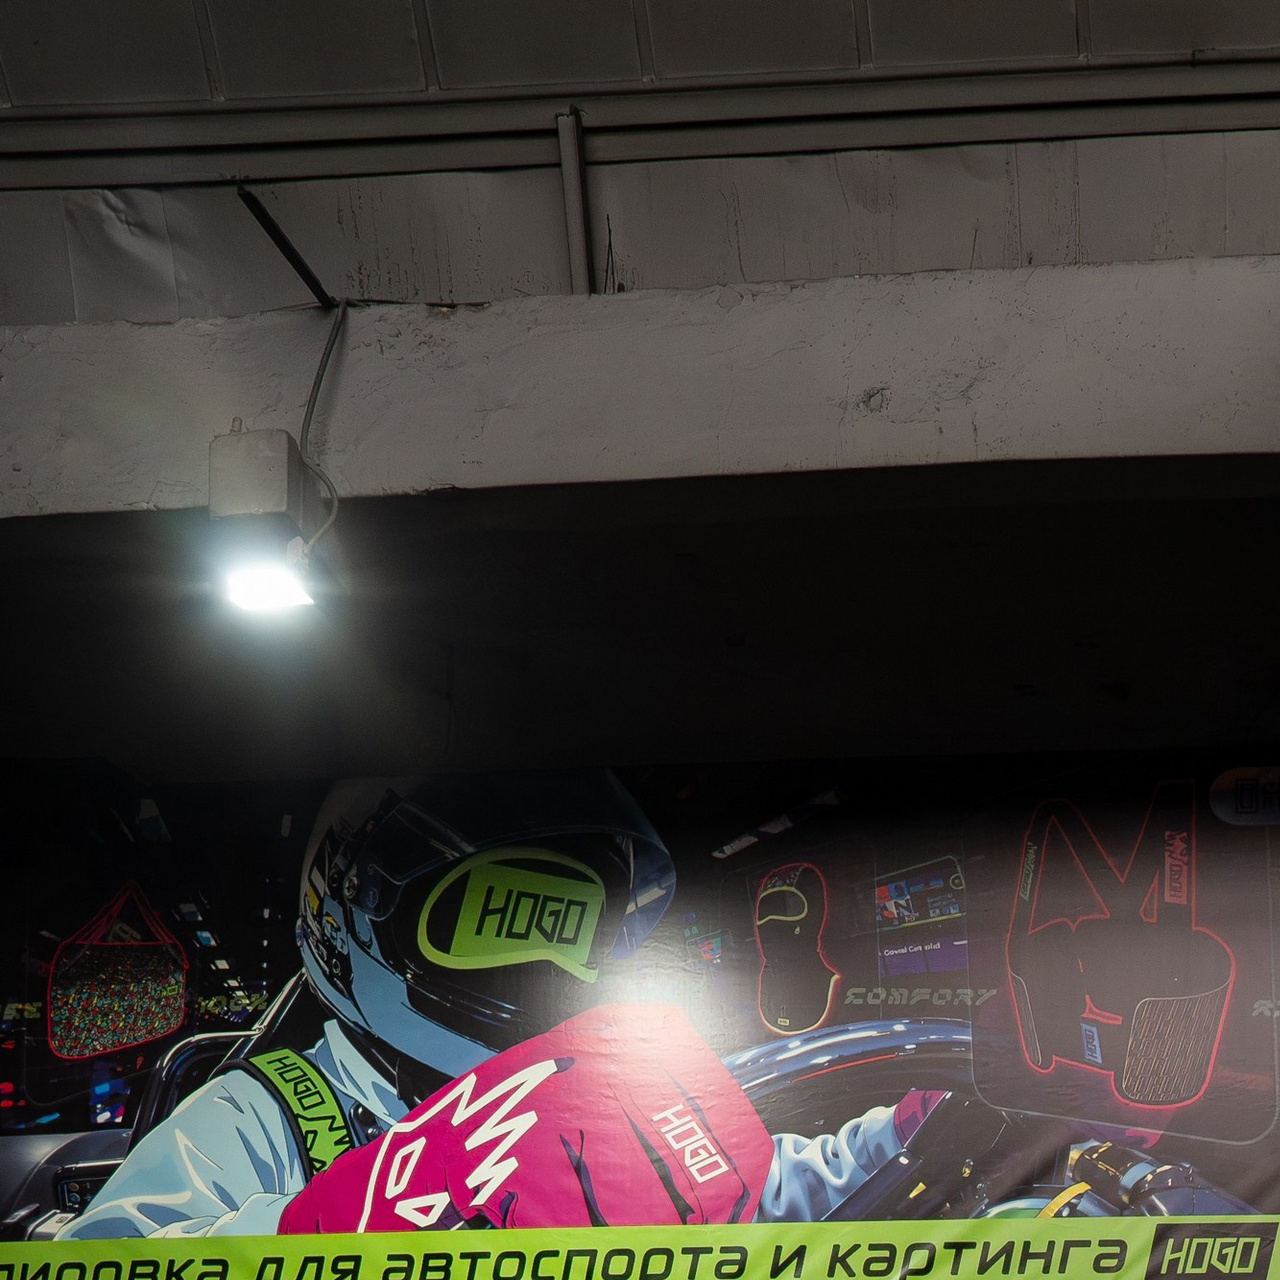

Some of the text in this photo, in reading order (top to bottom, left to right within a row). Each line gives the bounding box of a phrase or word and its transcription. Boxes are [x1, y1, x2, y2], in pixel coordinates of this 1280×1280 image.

[474, 883, 589, 946] HOGO
[266, 1050, 326, 1113] HOGO
[652, 1103, 729, 1183] HOGO
[769, 1246, 804, 1280] и
[1161, 1235, 1261, 1275] HOGO
